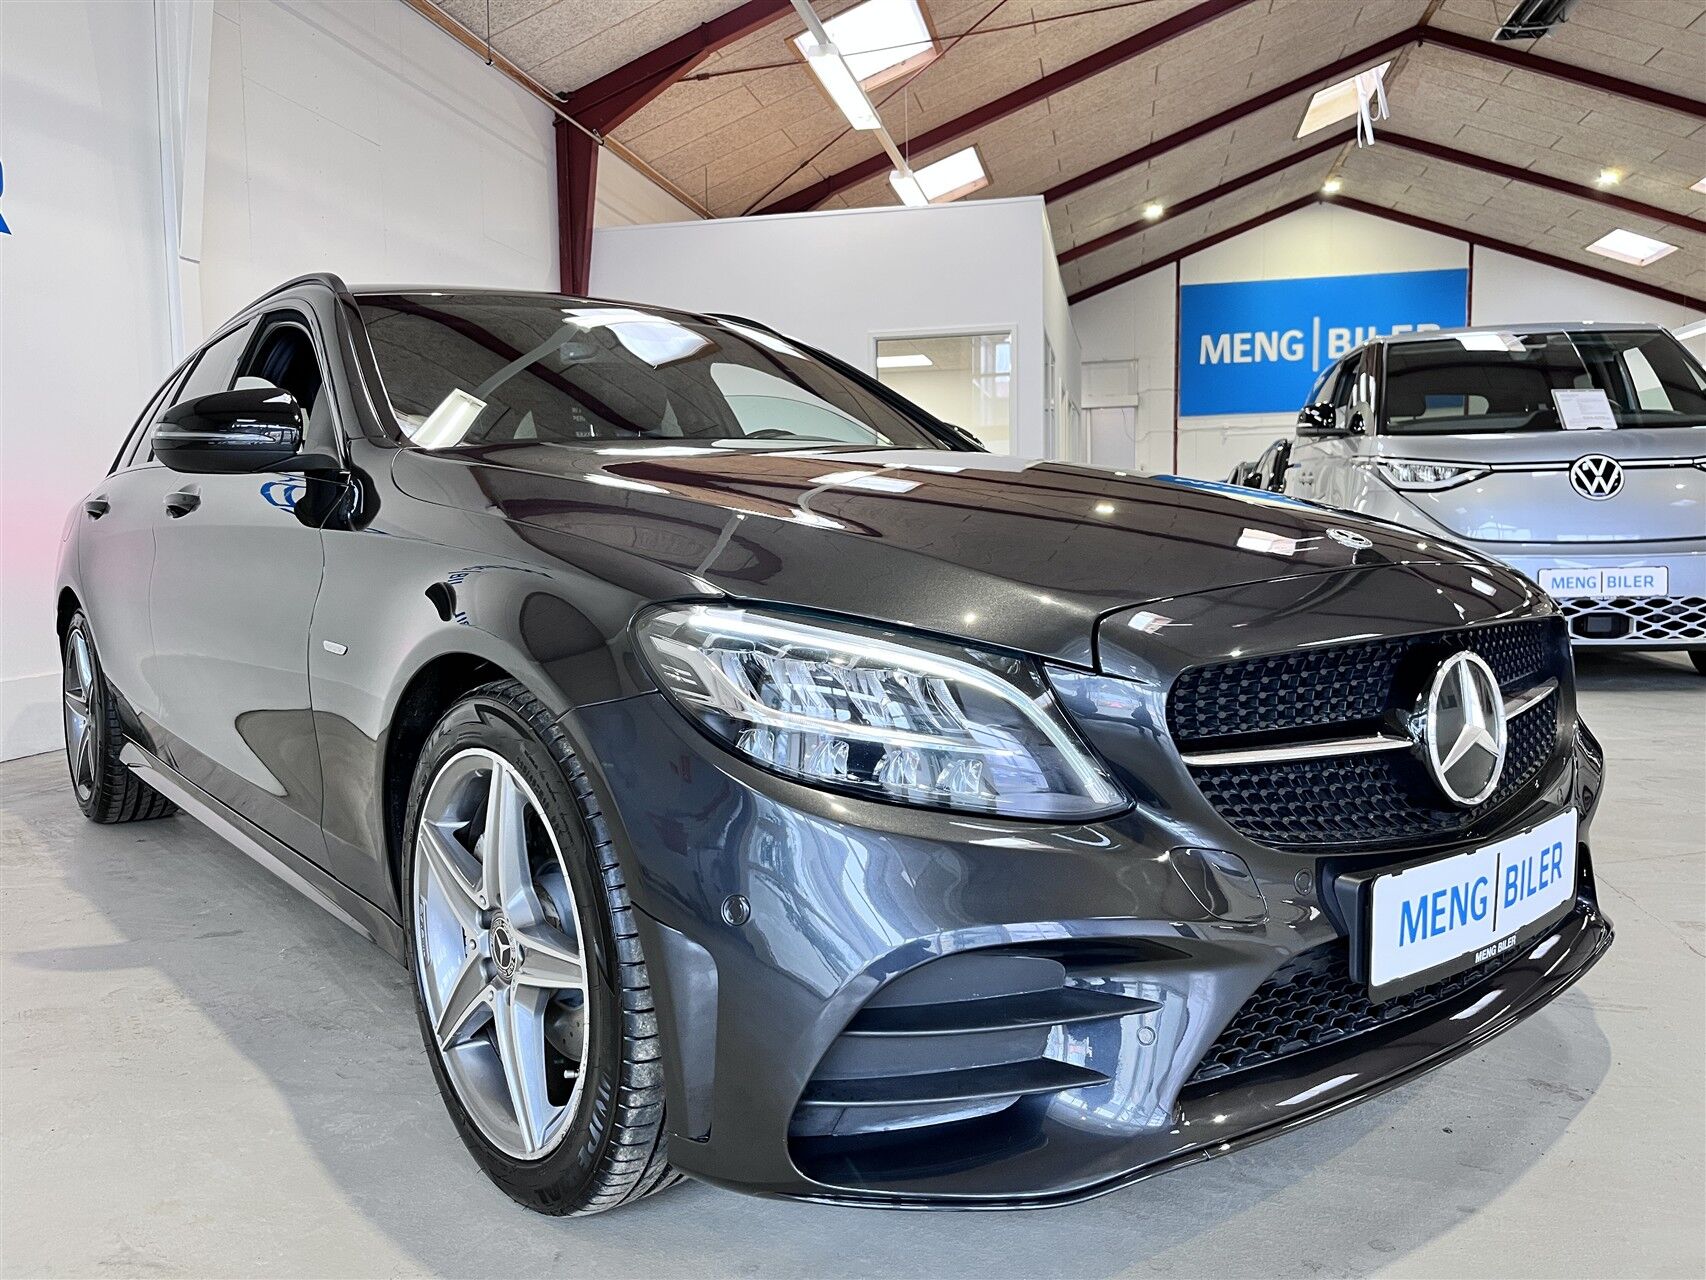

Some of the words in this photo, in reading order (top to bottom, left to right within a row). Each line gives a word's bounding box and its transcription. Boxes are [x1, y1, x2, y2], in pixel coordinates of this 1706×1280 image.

[1200, 329, 1304, 365] MENG
[1551, 576, 1597, 589] MENG
[1607, 575, 1654, 588] BILER
[1399, 876, 1488, 947] MENG
[1504, 841, 1563, 909] BILER
[1475, 945, 1497, 964] MENG
[1497, 934, 1516, 955] BILER
